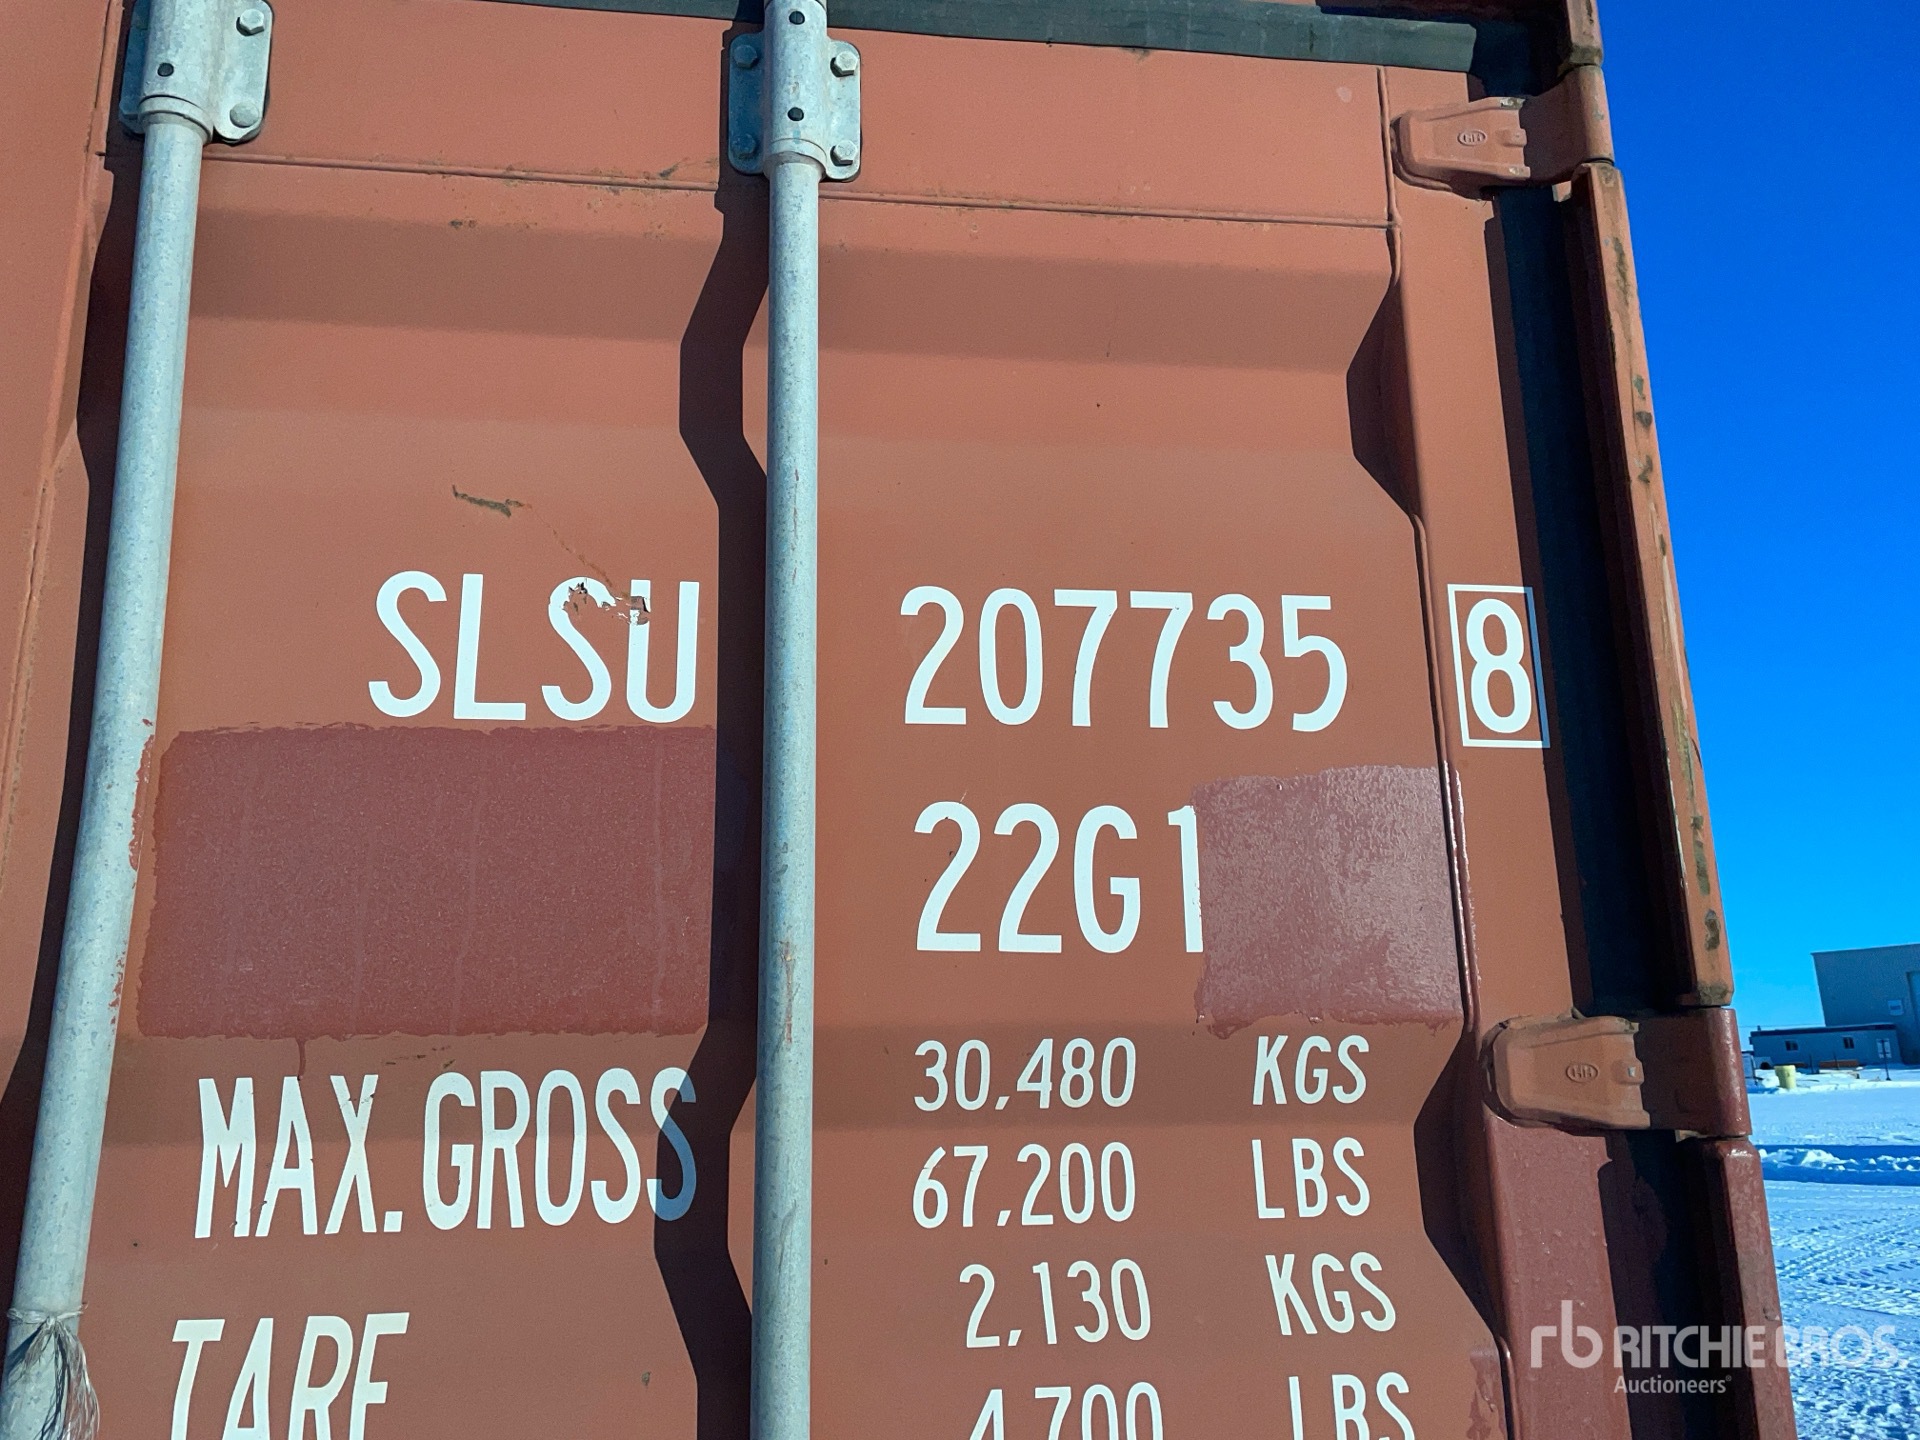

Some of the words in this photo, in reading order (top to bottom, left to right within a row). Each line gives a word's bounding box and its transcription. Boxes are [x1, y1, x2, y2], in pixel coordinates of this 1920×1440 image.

[369, 570, 700, 723] SLSU
[900, 585, 1348, 732] 207735
[1466, 598, 1532, 733] 8
[914, 801, 1204, 953] 22G1
[914, 1037, 1137, 1112] 30,480
[1252, 1035, 1370, 1106] KGS
[912, 1141, 1136, 1229] 67,200
[1251, 1136, 1371, 1219] LBS
[959, 1258, 1151, 1348] 2,130
[1265, 1251, 1397, 1336] KGS
